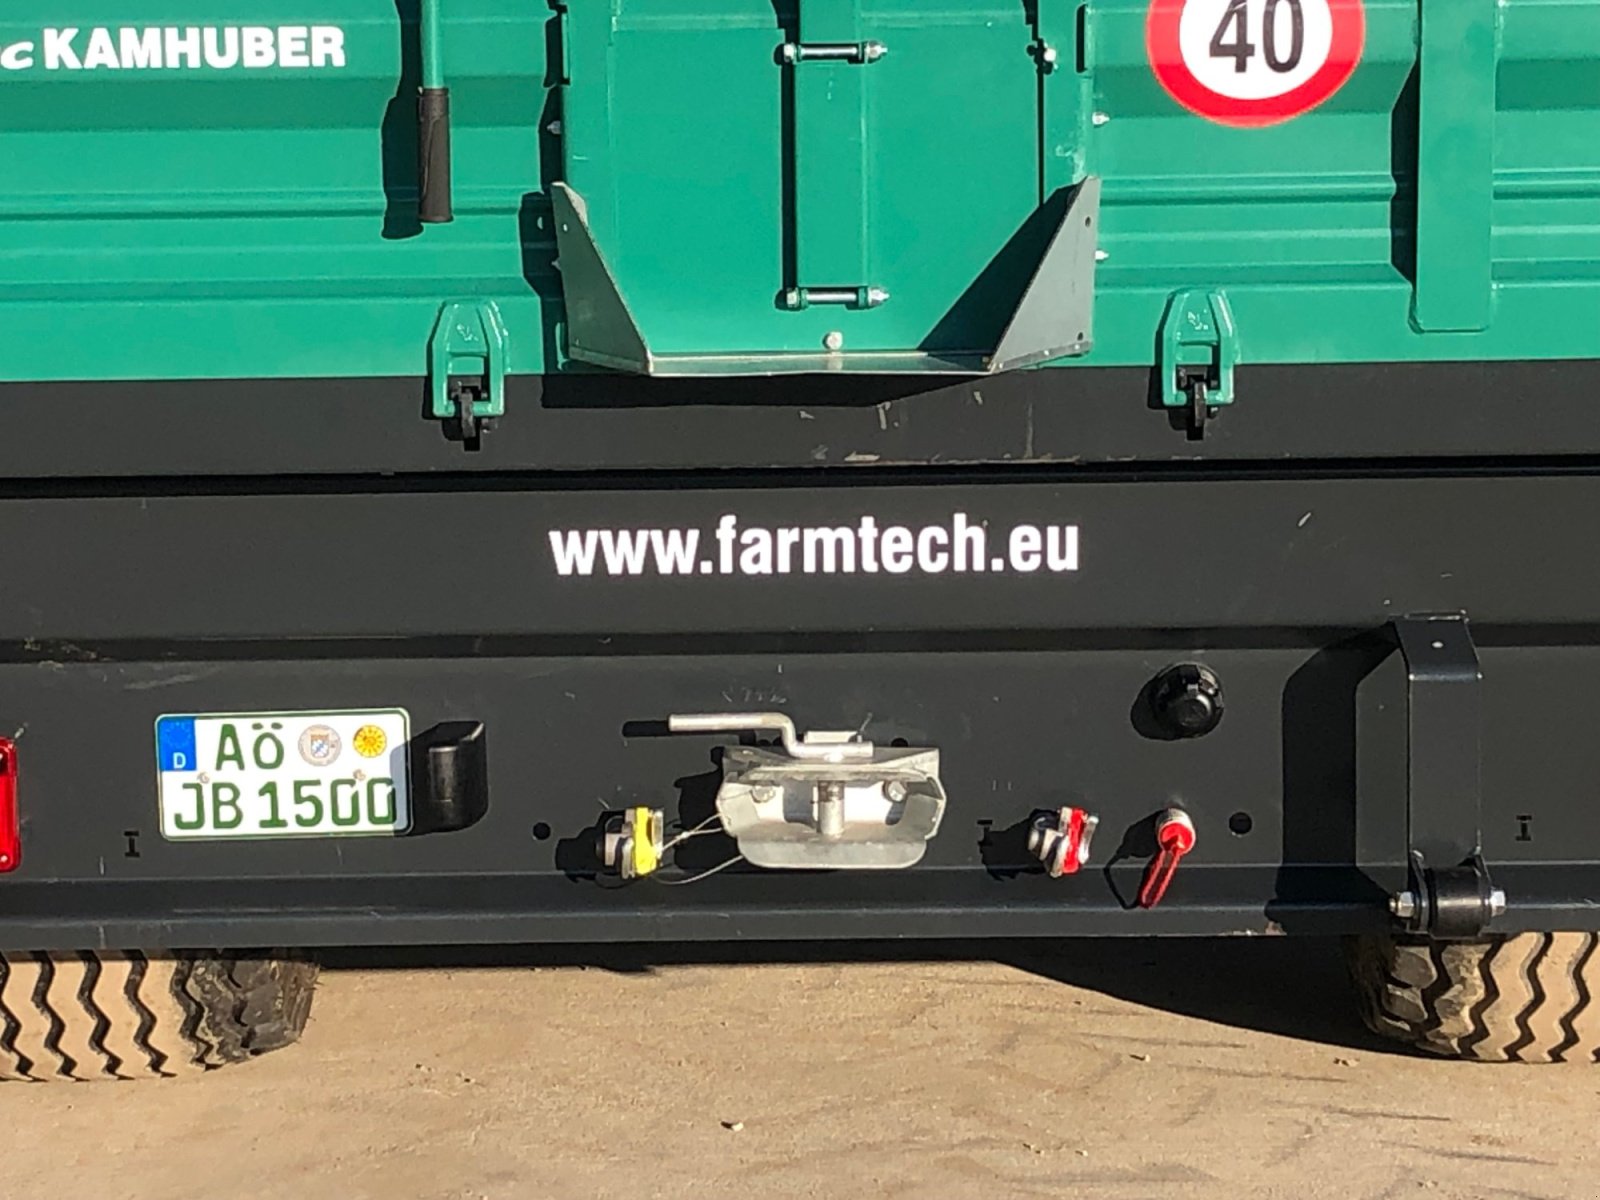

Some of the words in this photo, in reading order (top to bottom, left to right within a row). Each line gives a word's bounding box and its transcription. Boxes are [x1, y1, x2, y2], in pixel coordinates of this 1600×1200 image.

[43, 26, 346, 70] KAMHUBER
[1208, 0, 1304, 73] 40
[548, 512, 1079, 576] www.farmtech.eu
[173, 752, 186, 769] D
[215, 722, 285, 771] AÖ
[174, 782, 243, 830] JB
[258, 778, 397, 829] 1500
